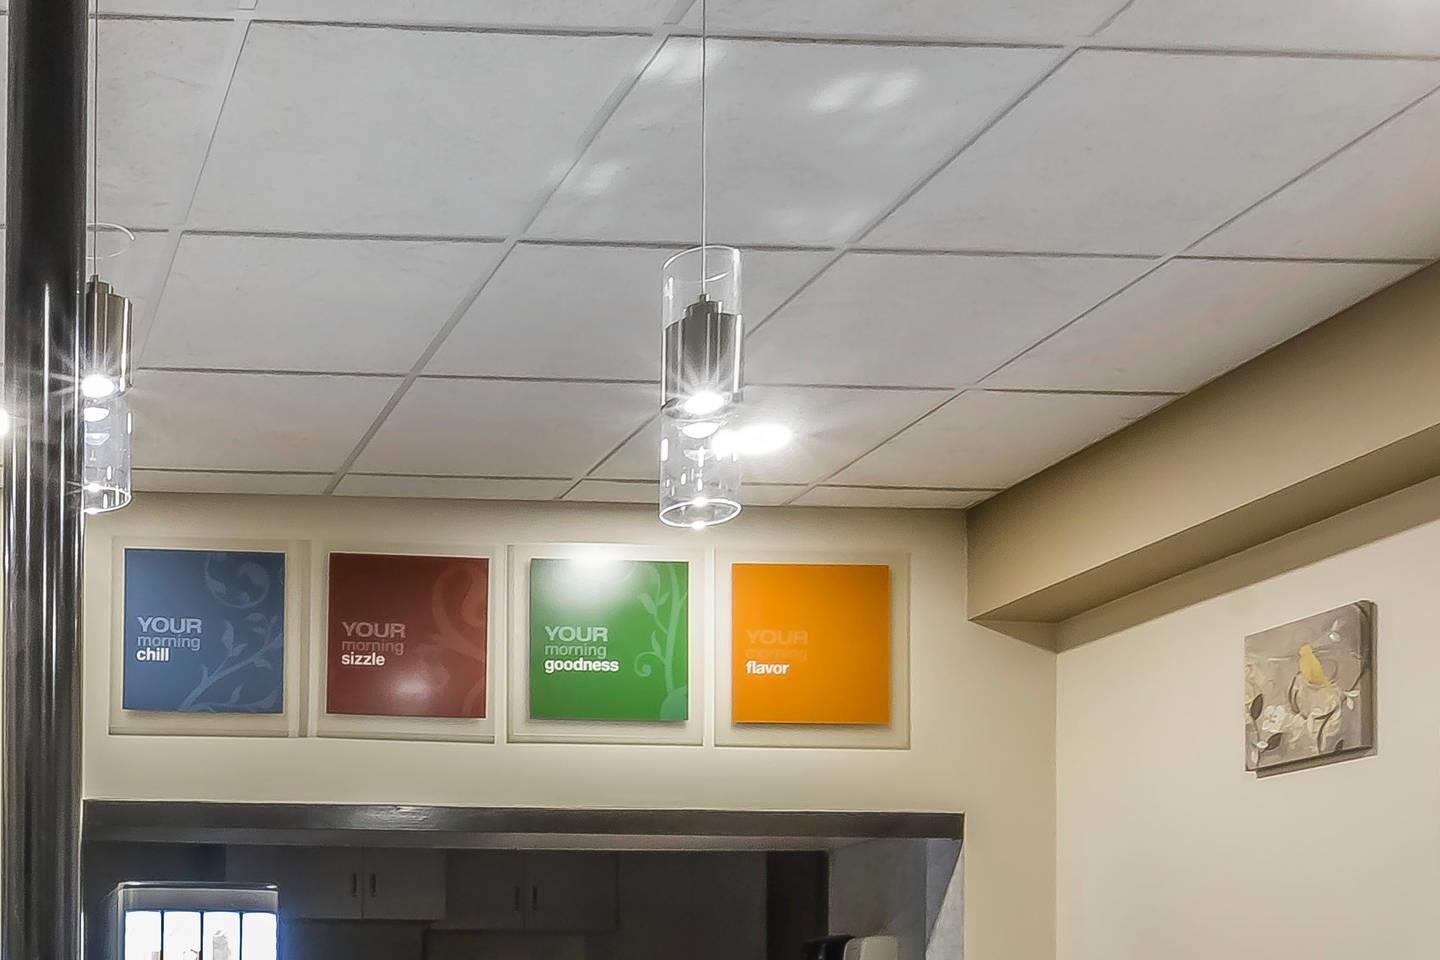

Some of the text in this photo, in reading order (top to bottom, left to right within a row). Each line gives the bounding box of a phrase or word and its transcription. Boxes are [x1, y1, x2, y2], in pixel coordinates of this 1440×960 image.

[137, 616, 202, 633] YOUR
[342, 621, 406, 638] YOUR
[137, 634, 201, 651] morning
[544, 626, 608, 642] YOUR
[745, 629, 808, 645] YOUR
[136, 647, 169, 661] chill
[341, 639, 404, 656] morning
[544, 643, 607, 660] morning
[341, 651, 385, 666] sizzle
[544, 657, 619, 674] goodness
[745, 660, 790, 675] flavor
